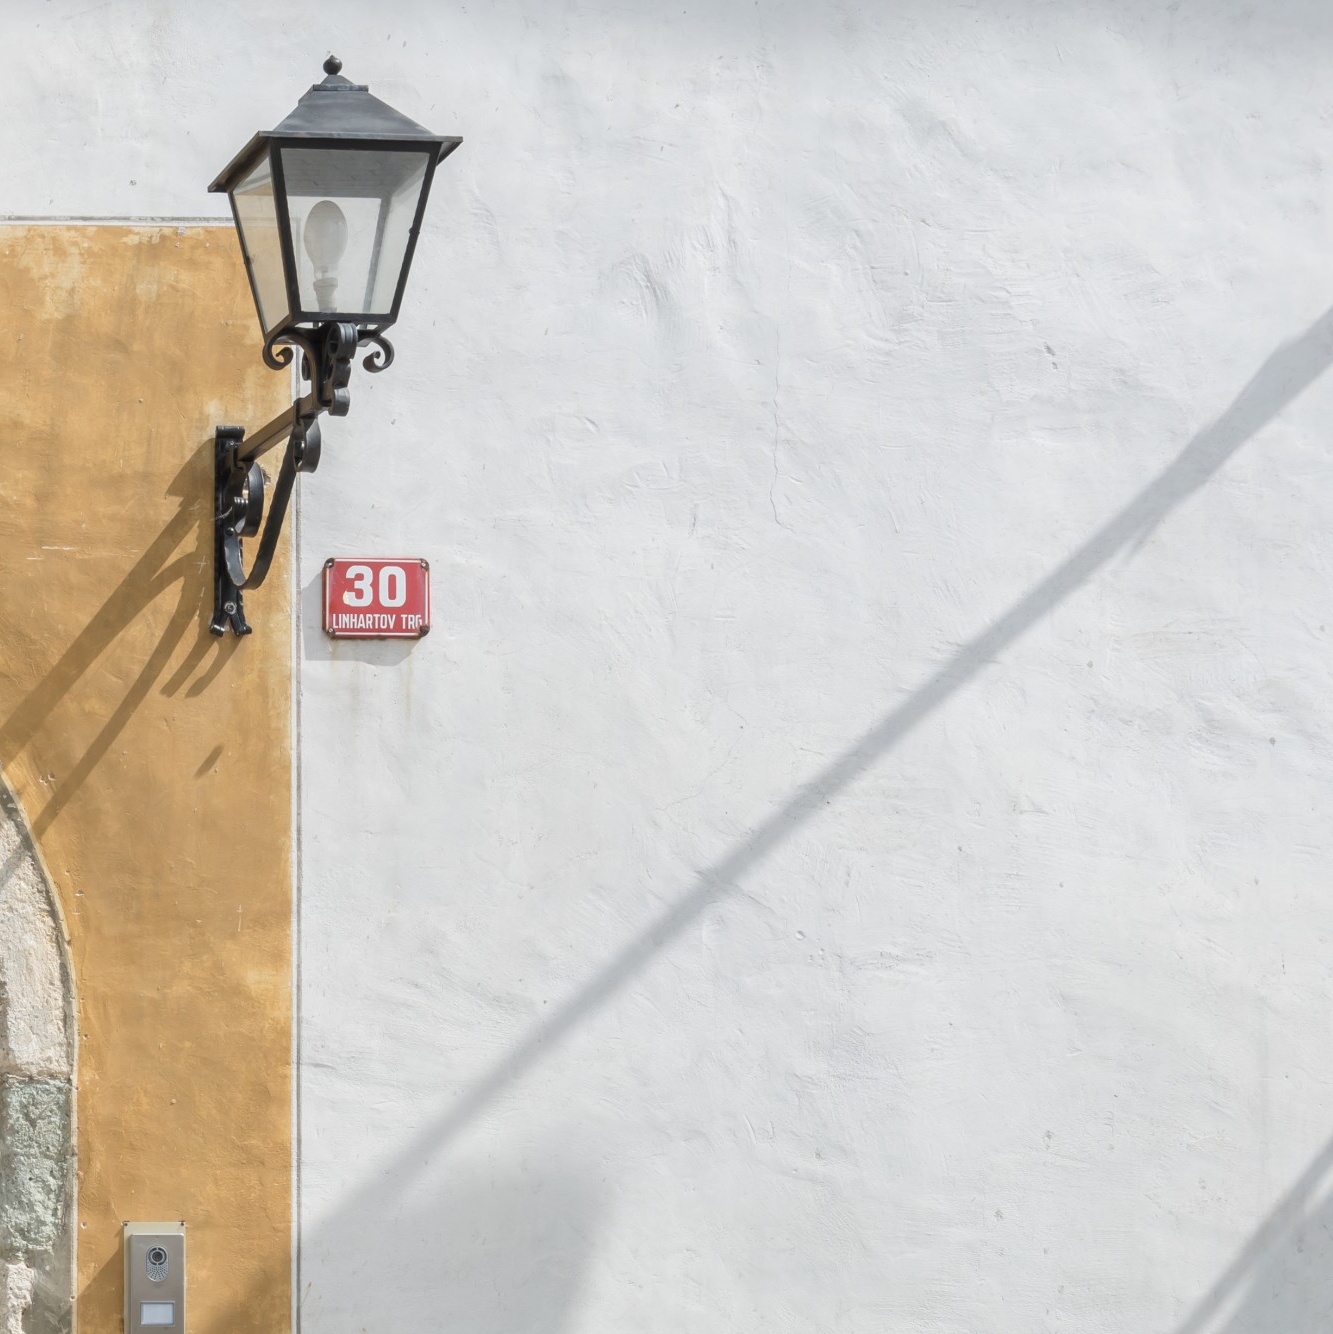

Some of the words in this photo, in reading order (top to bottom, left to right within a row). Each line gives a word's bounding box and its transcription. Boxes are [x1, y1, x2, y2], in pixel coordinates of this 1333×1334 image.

[343, 565, 406, 607] 30
[333, 613, 396, 629] LINHARTOV
[401, 614, 423, 630] TRG
